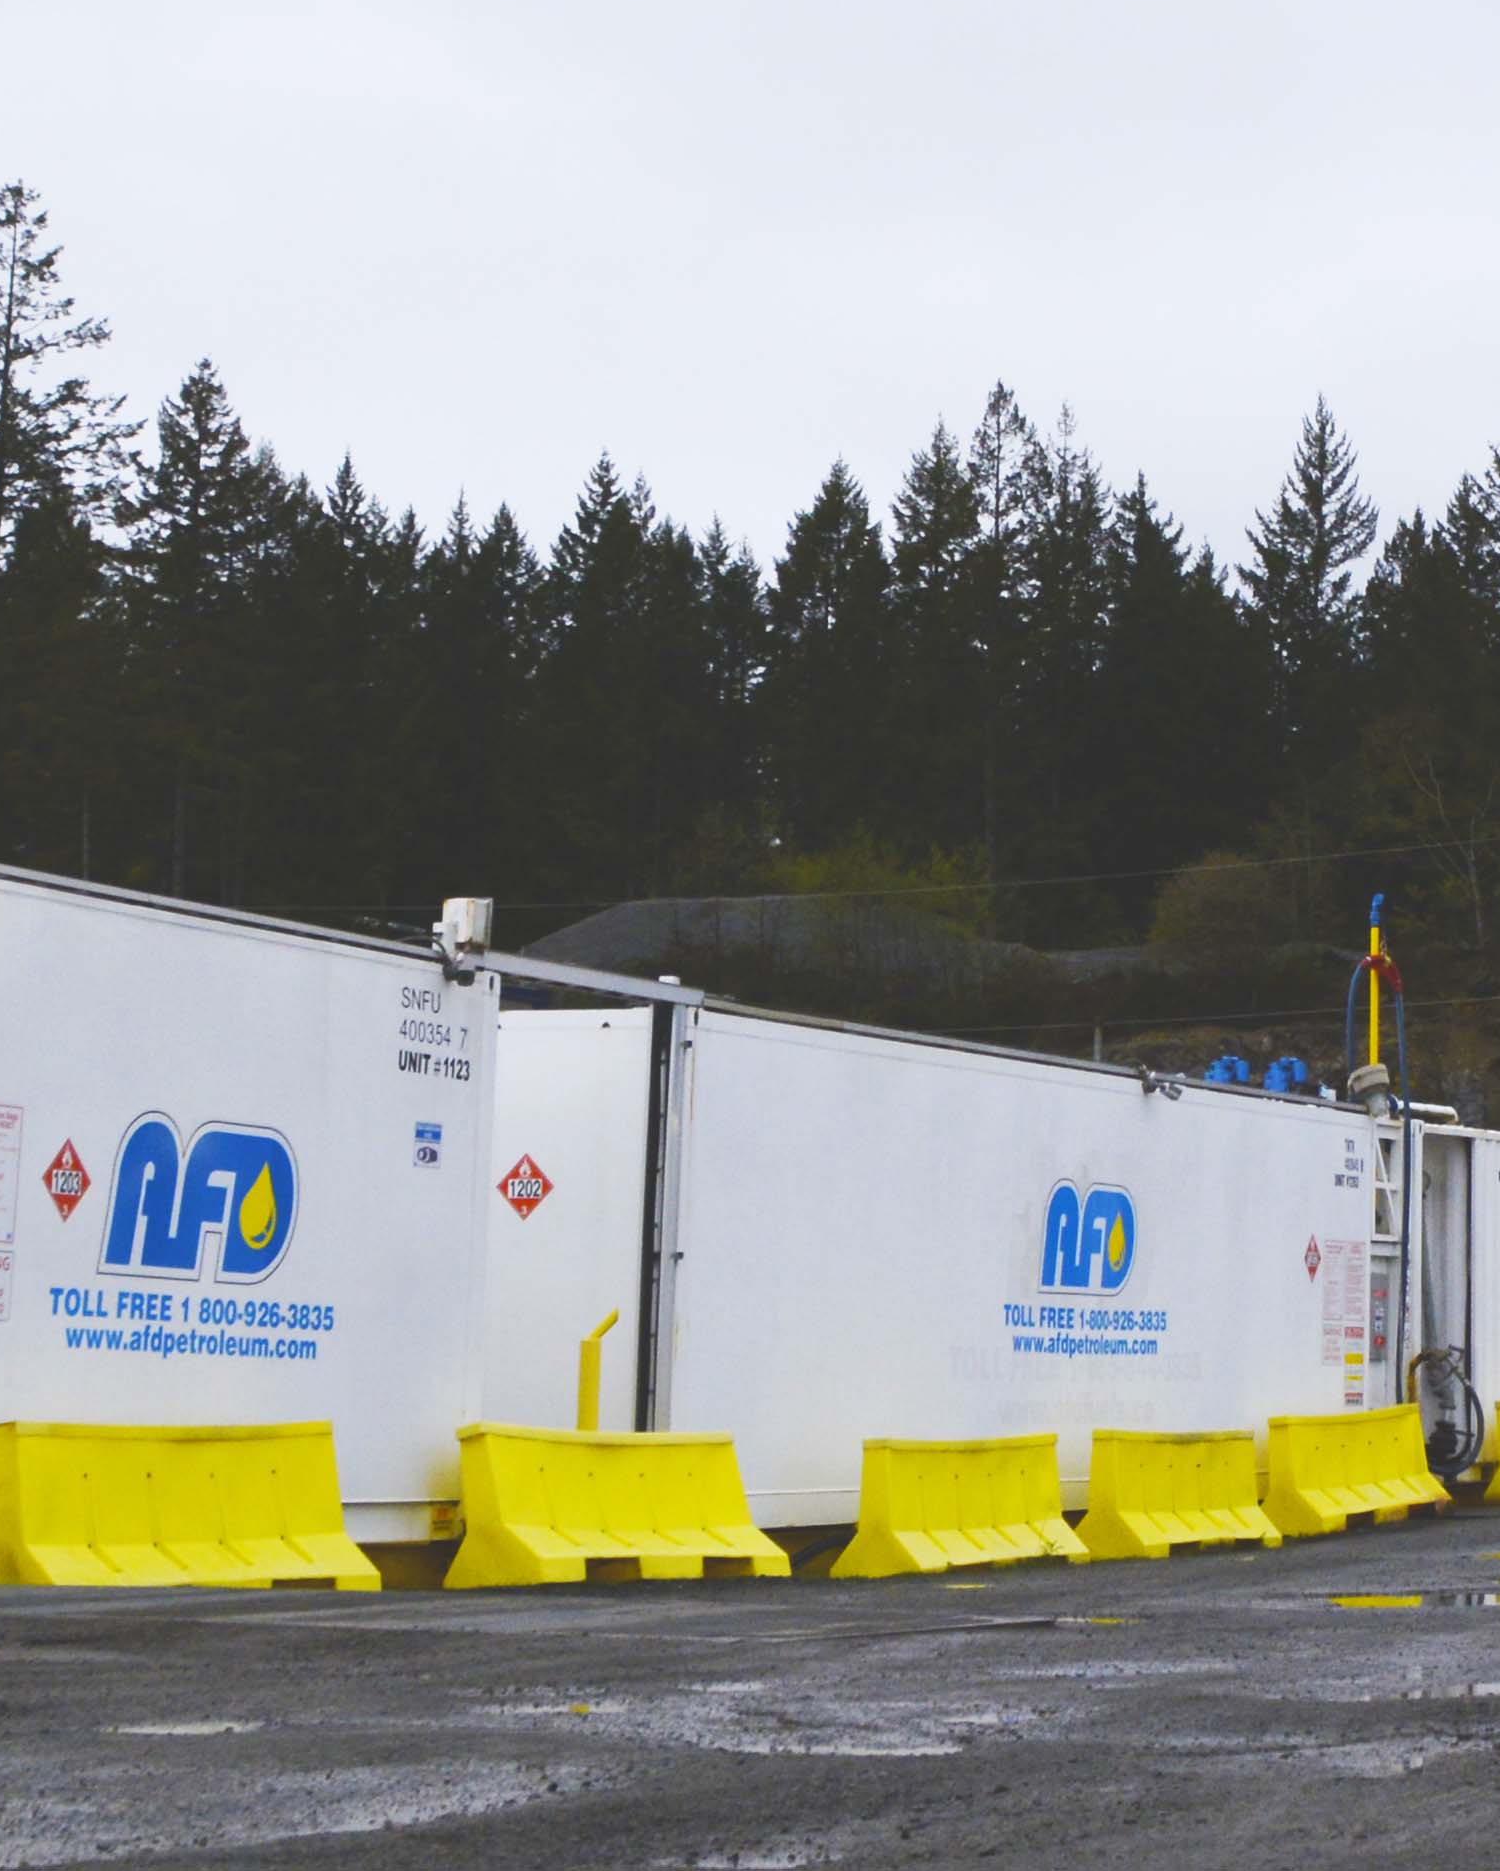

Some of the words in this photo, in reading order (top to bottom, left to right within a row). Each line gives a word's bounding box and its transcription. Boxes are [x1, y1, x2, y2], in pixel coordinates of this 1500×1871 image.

[401, 986, 442, 1013] SNFU
[399, 1019, 451, 1046] 400354
[460, 1028, 468, 1049] 7
[398, 1049, 431, 1075] UNIT
[53, 1171, 82, 1195] 1203
[103, 1118, 296, 1276] AFD
[510, 1180, 542, 1198] 1202
[1040, 1184, 1136, 1289] AFD
[50, 1287, 108, 1318] TOLL
[116, 1291, 173, 1321] FREE
[199, 1298, 335, 1331] 800-926-3835
[1004, 1303, 1035, 1328] TOLL
[1039, 1306, 1075, 1329] FREE
[1079, 1308, 1167, 1331] 1-800-926-3835
[65, 1325, 317, 1359] www.afdpetroleum.com
[1012, 1332, 1158, 1358] www.afdpetroleum.com
